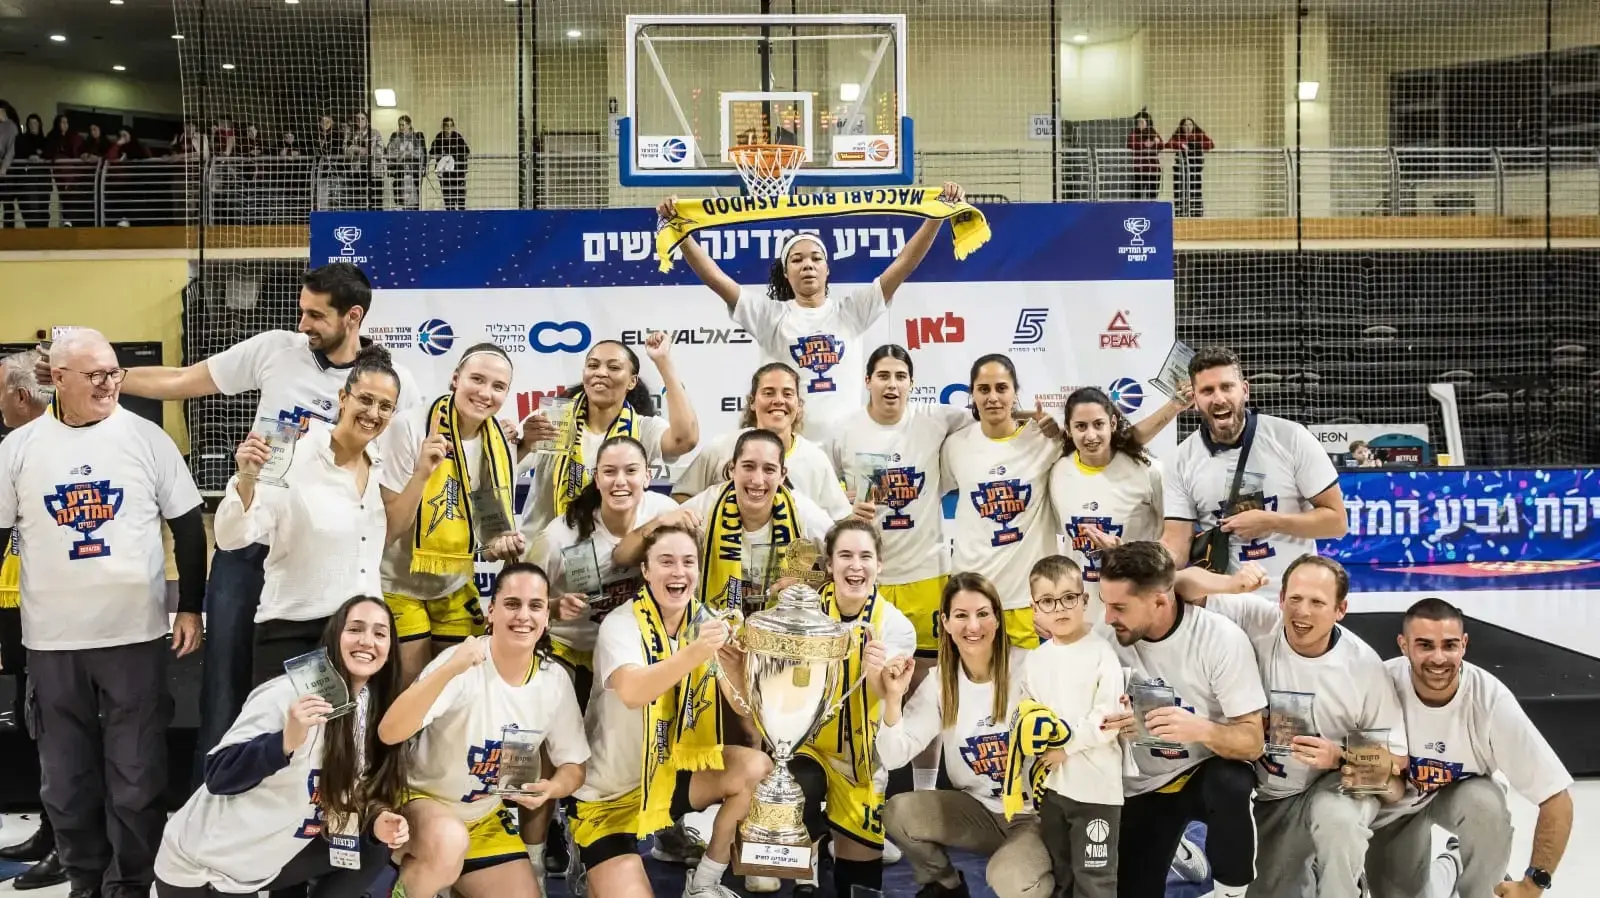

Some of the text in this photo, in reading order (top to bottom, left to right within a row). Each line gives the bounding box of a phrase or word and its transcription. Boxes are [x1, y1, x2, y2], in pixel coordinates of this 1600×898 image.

[701, 196, 779, 216] ASHDOD
[582, 227, 906, 262] גביע מדינה שים
[485, 324, 525, 333] הרצליה
[905, 312, 965, 350] לאן
[1012, 308, 1049, 344] 5
[492, 333, 525, 343] מדיקל
[1099, 333, 1141, 349] PEAK
[66, 488, 102, 508] גביע
[986, 486, 1014, 502] גביע
[56, 503, 115, 527] המדינה
[979, 499, 1026, 518] המדינה
[1433, 498, 1519, 537] גביע
[719, 494, 742, 561] MACCA
[1417, 765, 1452, 783] גביע
[1093, 843, 1107, 858] NBA
